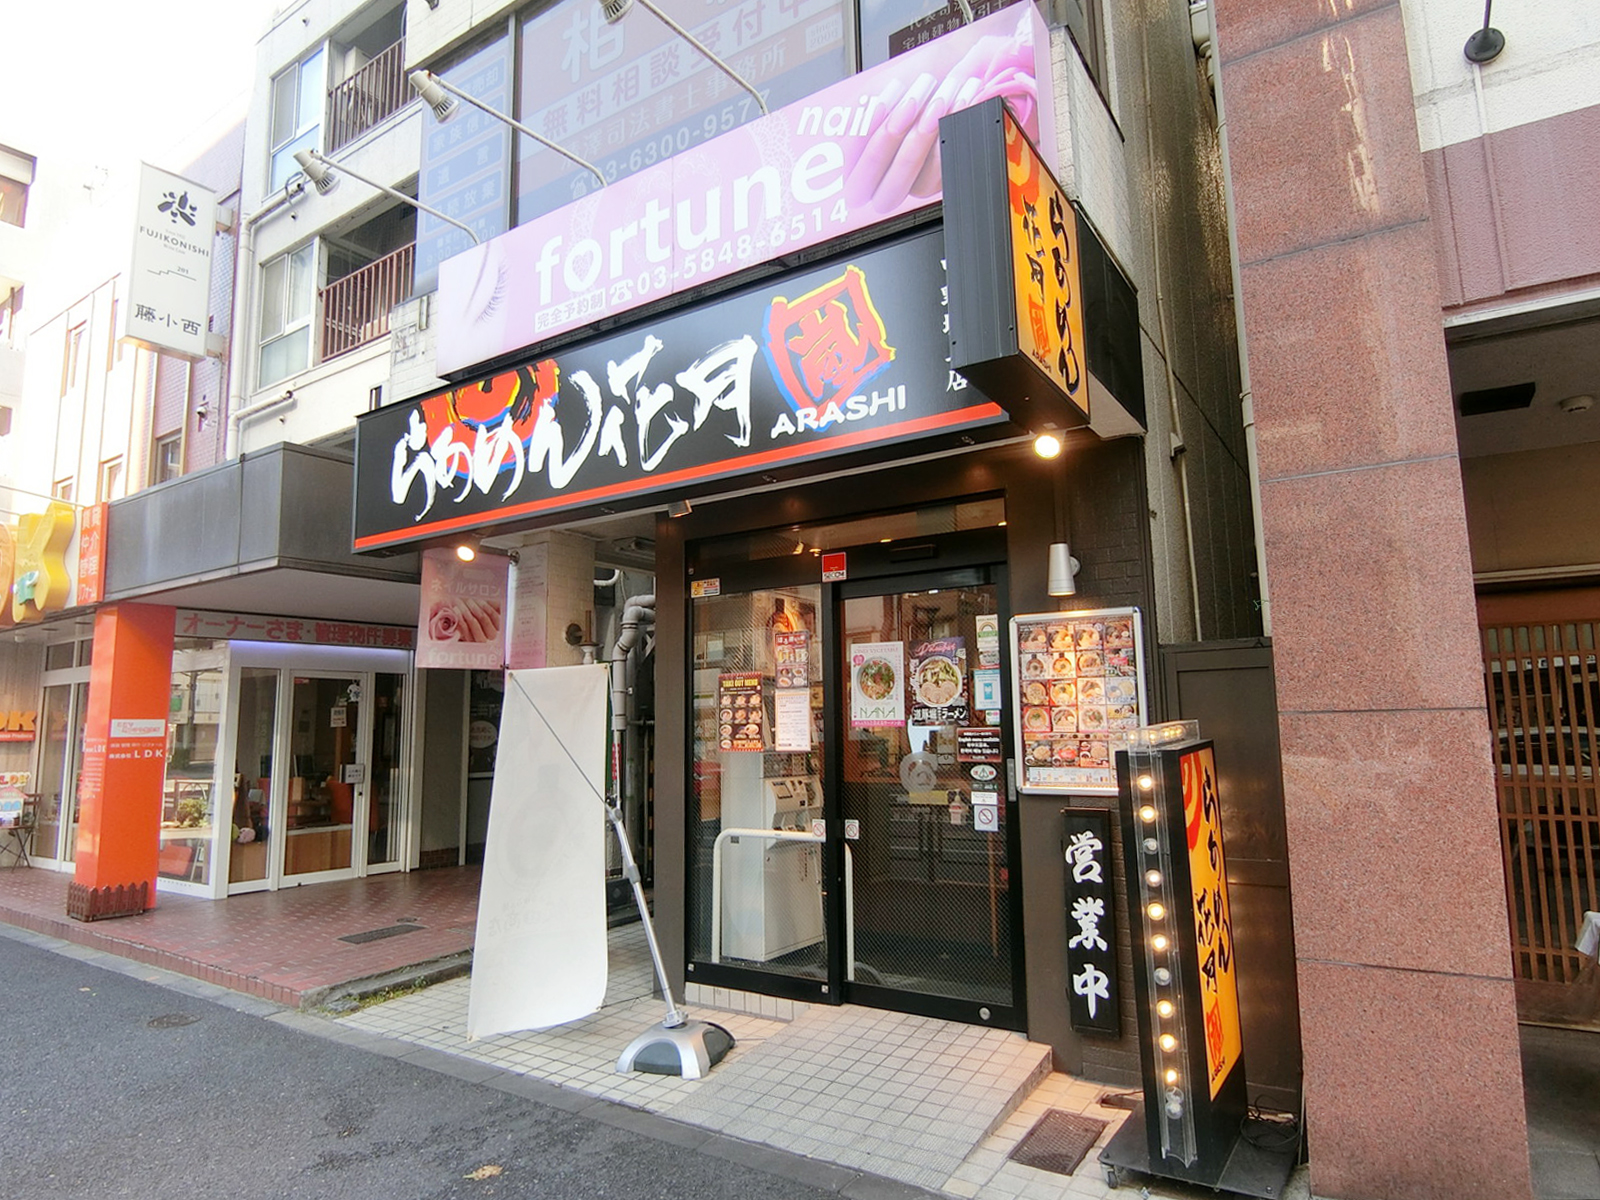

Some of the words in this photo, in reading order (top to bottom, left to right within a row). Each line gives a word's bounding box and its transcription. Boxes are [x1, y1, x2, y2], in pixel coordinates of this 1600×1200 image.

[796, 95, 879, 137] nail
[139, 225, 209, 257] FUJIKONISHI
[535, 140, 845, 306] fortune
[637, 199, 849, 295] 03-5848-6514
[135, 303, 202, 336] 藤小西
[537, 291, 604, 331] 完全予約制
[770, 384, 907, 439] ARASHI
[427, 647, 499, 667] fortune
[1064, 830, 1110, 1020] 営業中
